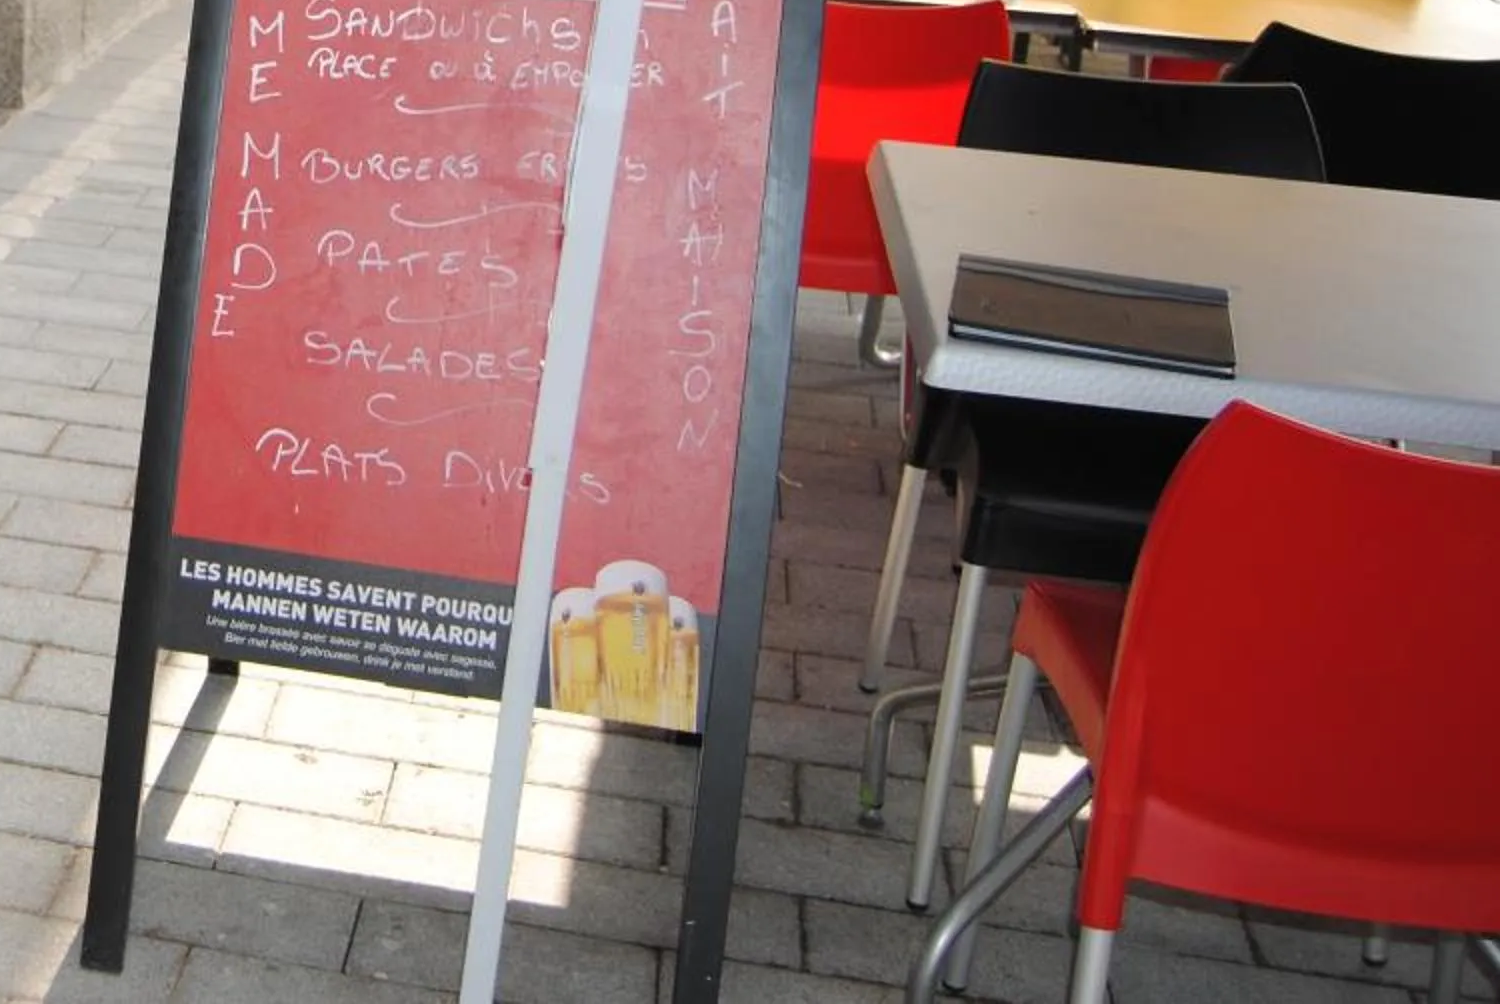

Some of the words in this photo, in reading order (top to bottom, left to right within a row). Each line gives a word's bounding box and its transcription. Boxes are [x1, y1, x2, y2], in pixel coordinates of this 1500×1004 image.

[308, 47, 398, 81] PLACE
[211, 132, 280, 338] MADE
[304, 331, 543, 382] SALADES
[255, 427, 407, 486] PLATS
[180, 557, 222, 582] LES
[227, 565, 323, 598] HOMMES
[327, 579, 416, 611] SAVENT
[212, 588, 307, 621] MANNEN
[313, 602, 392, 633] WETEN
[396, 615, 498, 650] WAAROM
